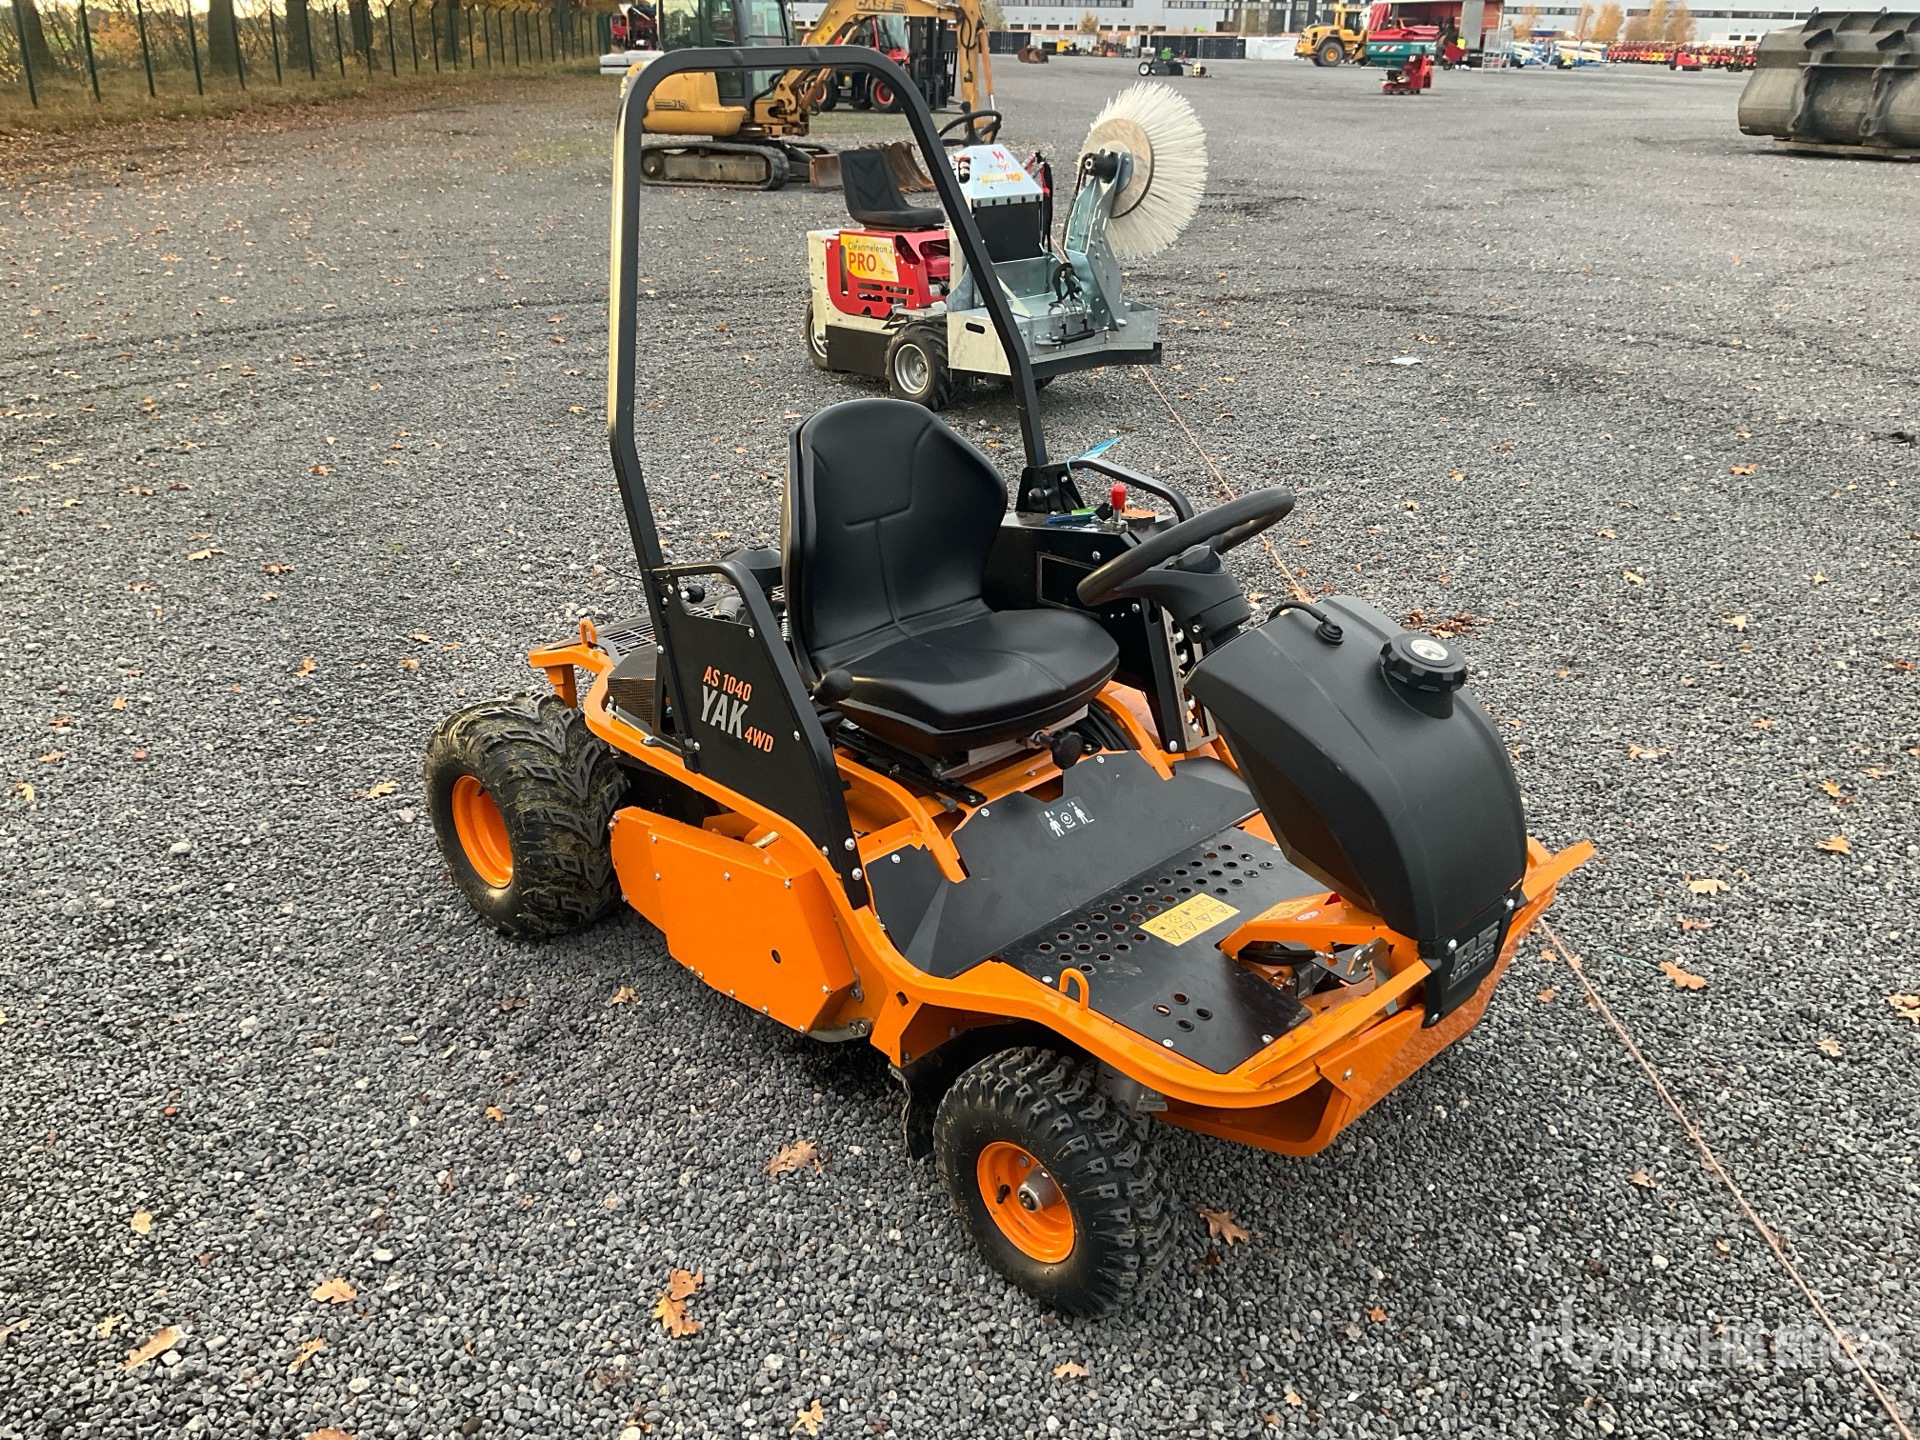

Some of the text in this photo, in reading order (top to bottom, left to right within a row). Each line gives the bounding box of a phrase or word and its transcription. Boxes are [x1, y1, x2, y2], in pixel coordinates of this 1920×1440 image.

[855, 0, 894, 11] CASE
[848, 241, 893, 253] Cleanmeleon 2
[848, 252, 876, 272] PRO
[703, 666, 752, 702] AS 1040
[701, 685, 749, 740] YAK
[744, 726, 774, 753] 4WD
